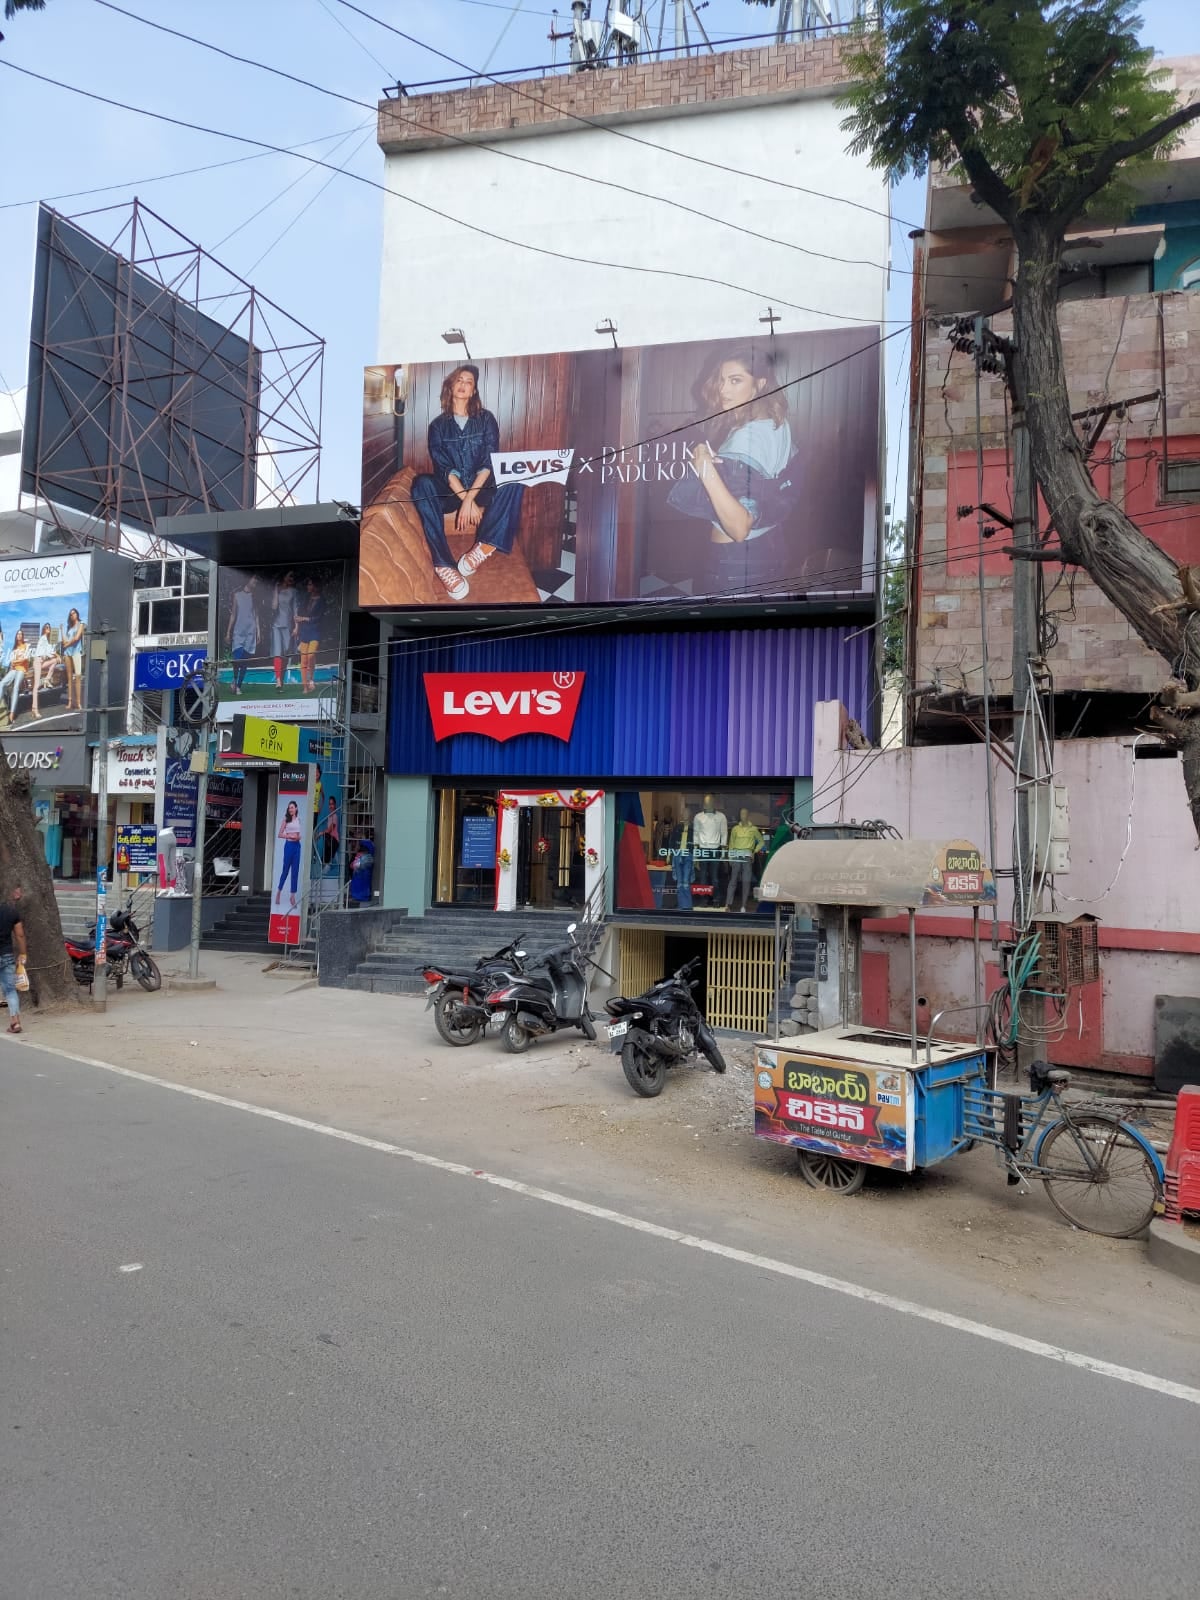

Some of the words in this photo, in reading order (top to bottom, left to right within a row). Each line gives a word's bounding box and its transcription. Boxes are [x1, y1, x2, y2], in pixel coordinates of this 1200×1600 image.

[4, 568, 20, 582] GO
[260, 738, 283, 752] PIPIN
[4, 746, 62, 769] OLORS!
[117, 748, 144, 762] Touch
[125, 767, 151, 776] Cosmetic
[658, 848, 690, 857] GIVE
[693, 849, 748, 859] BETTER
[788, 1071, 867, 1102] బాబాయ్
[785, 1097, 865, 1131] చికెన్
[799, 1123, 810, 1132] The
